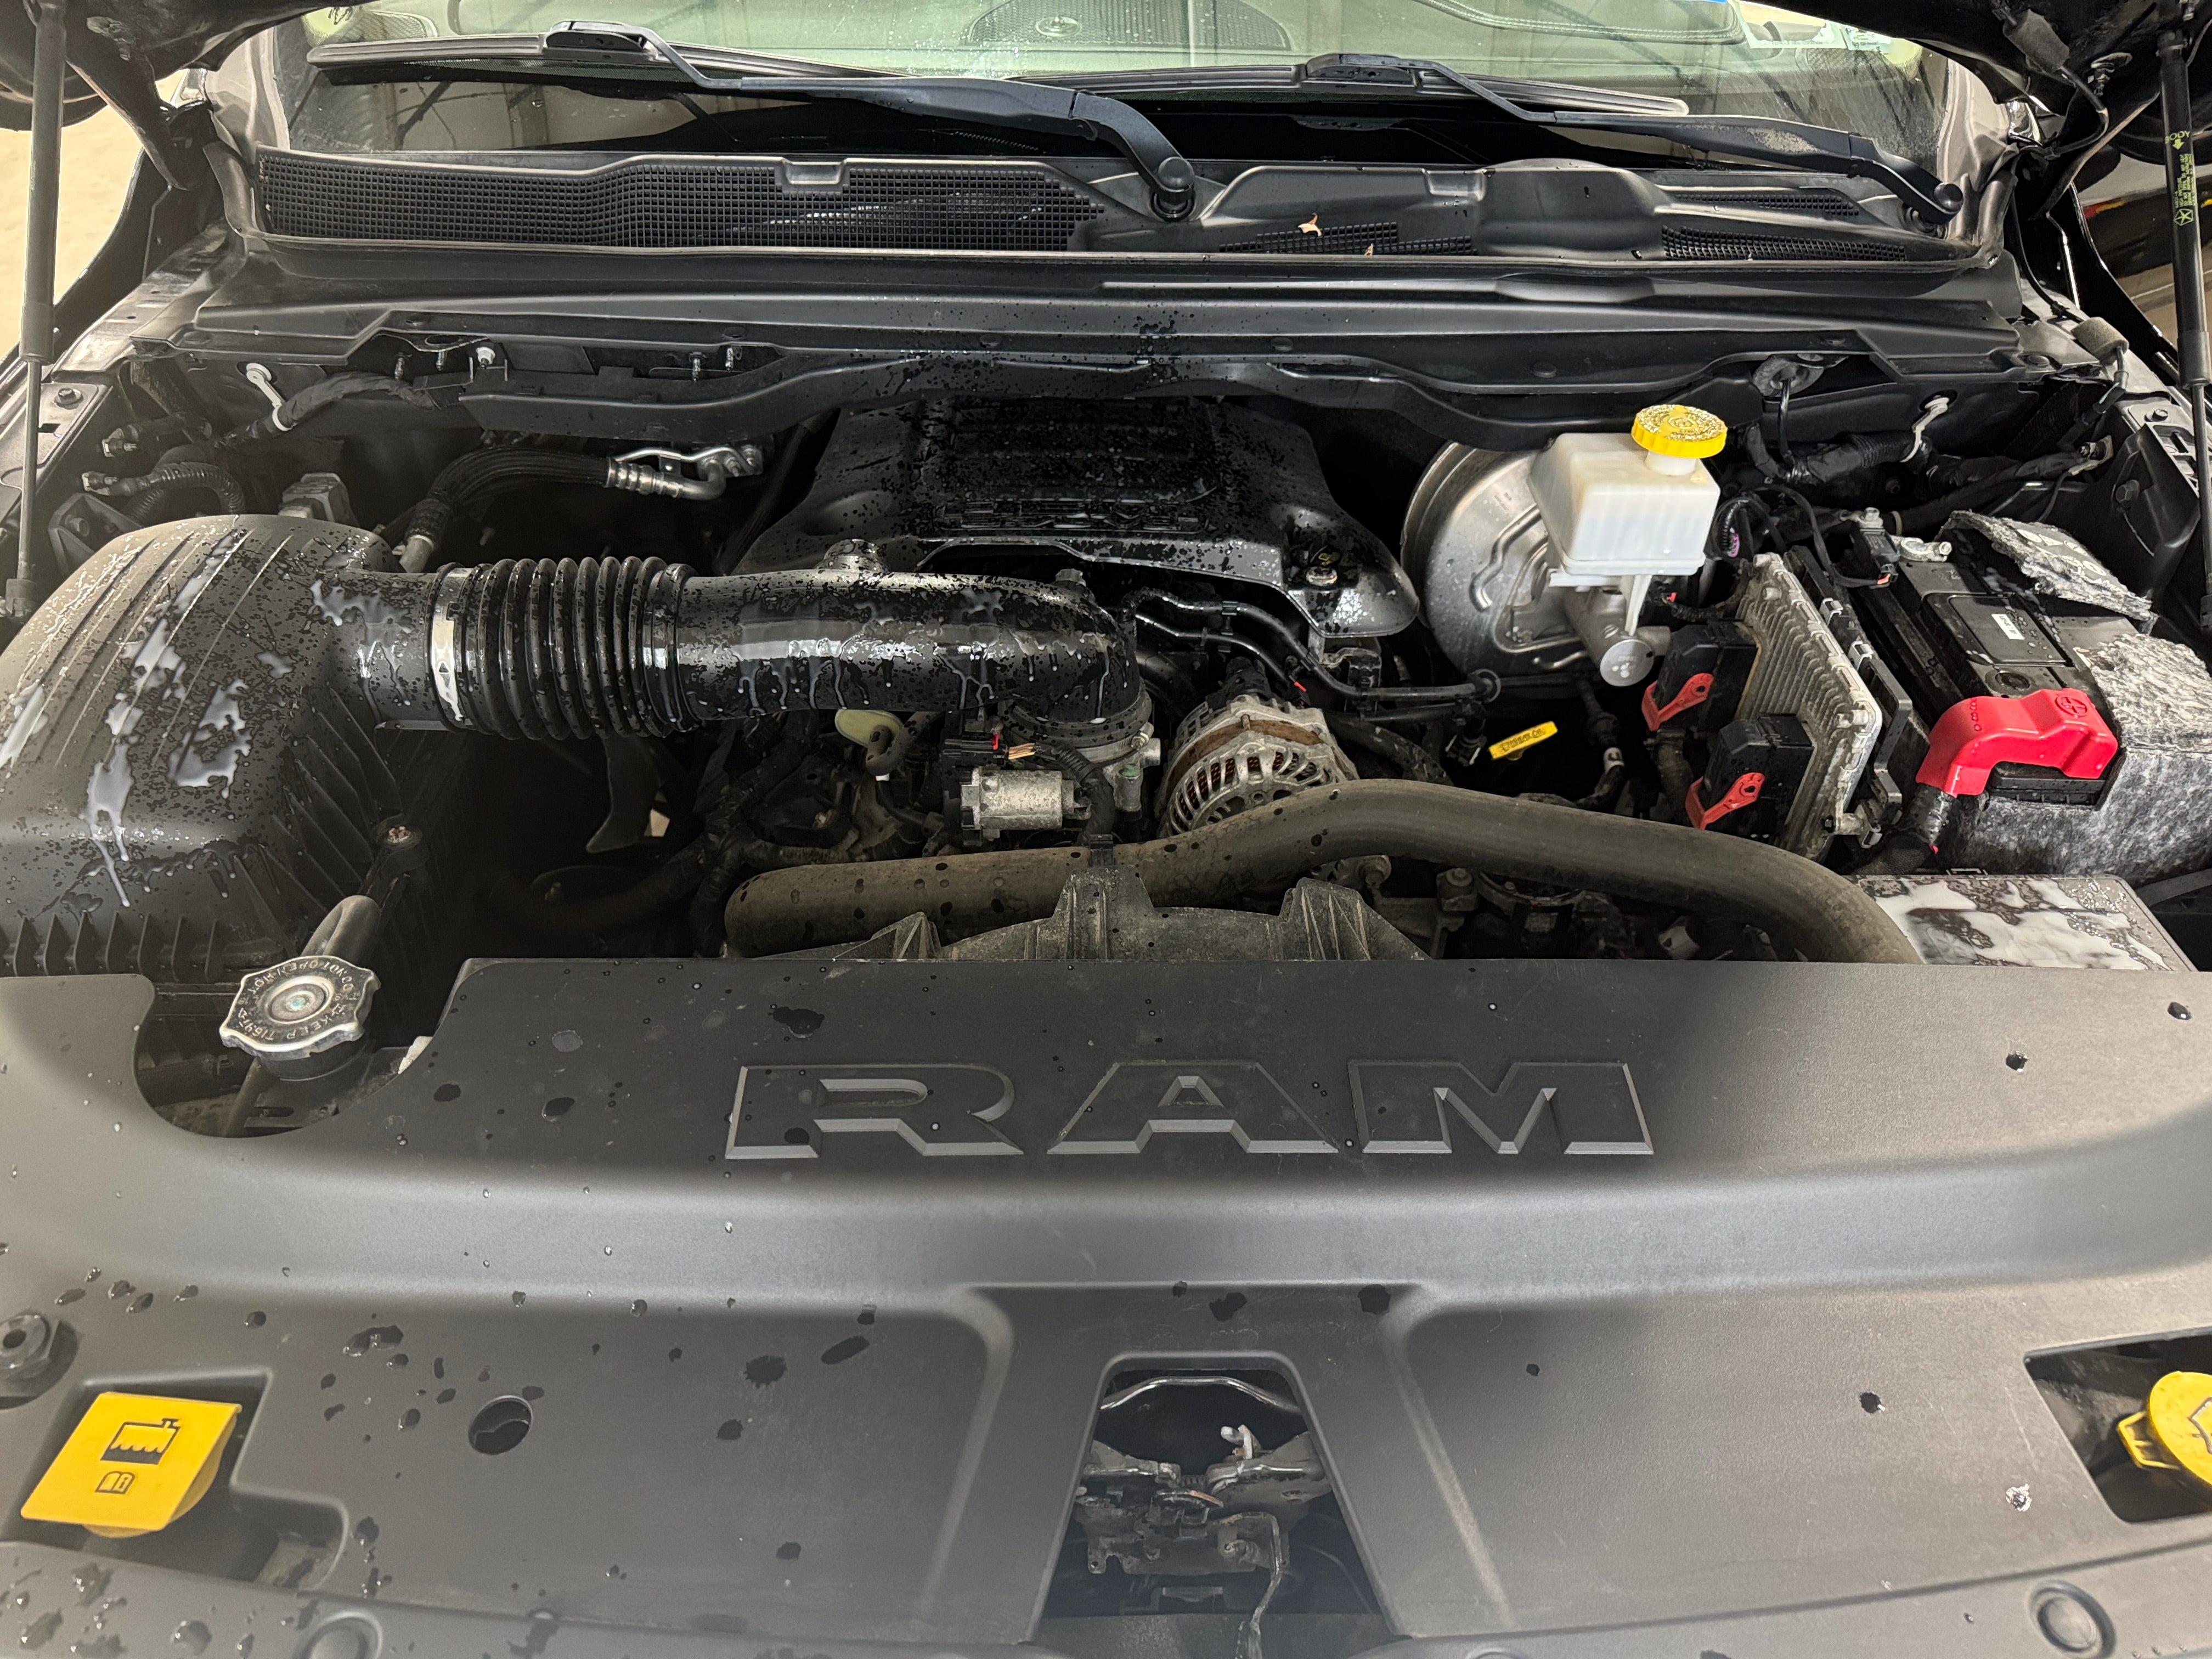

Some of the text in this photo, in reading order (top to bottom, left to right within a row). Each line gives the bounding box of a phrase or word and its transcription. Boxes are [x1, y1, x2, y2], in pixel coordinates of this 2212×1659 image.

[2165, 131, 2191, 144] BODY
[286, 1014, 332, 1040] KEEP
[725, 1059, 1654, 1159] RAM
